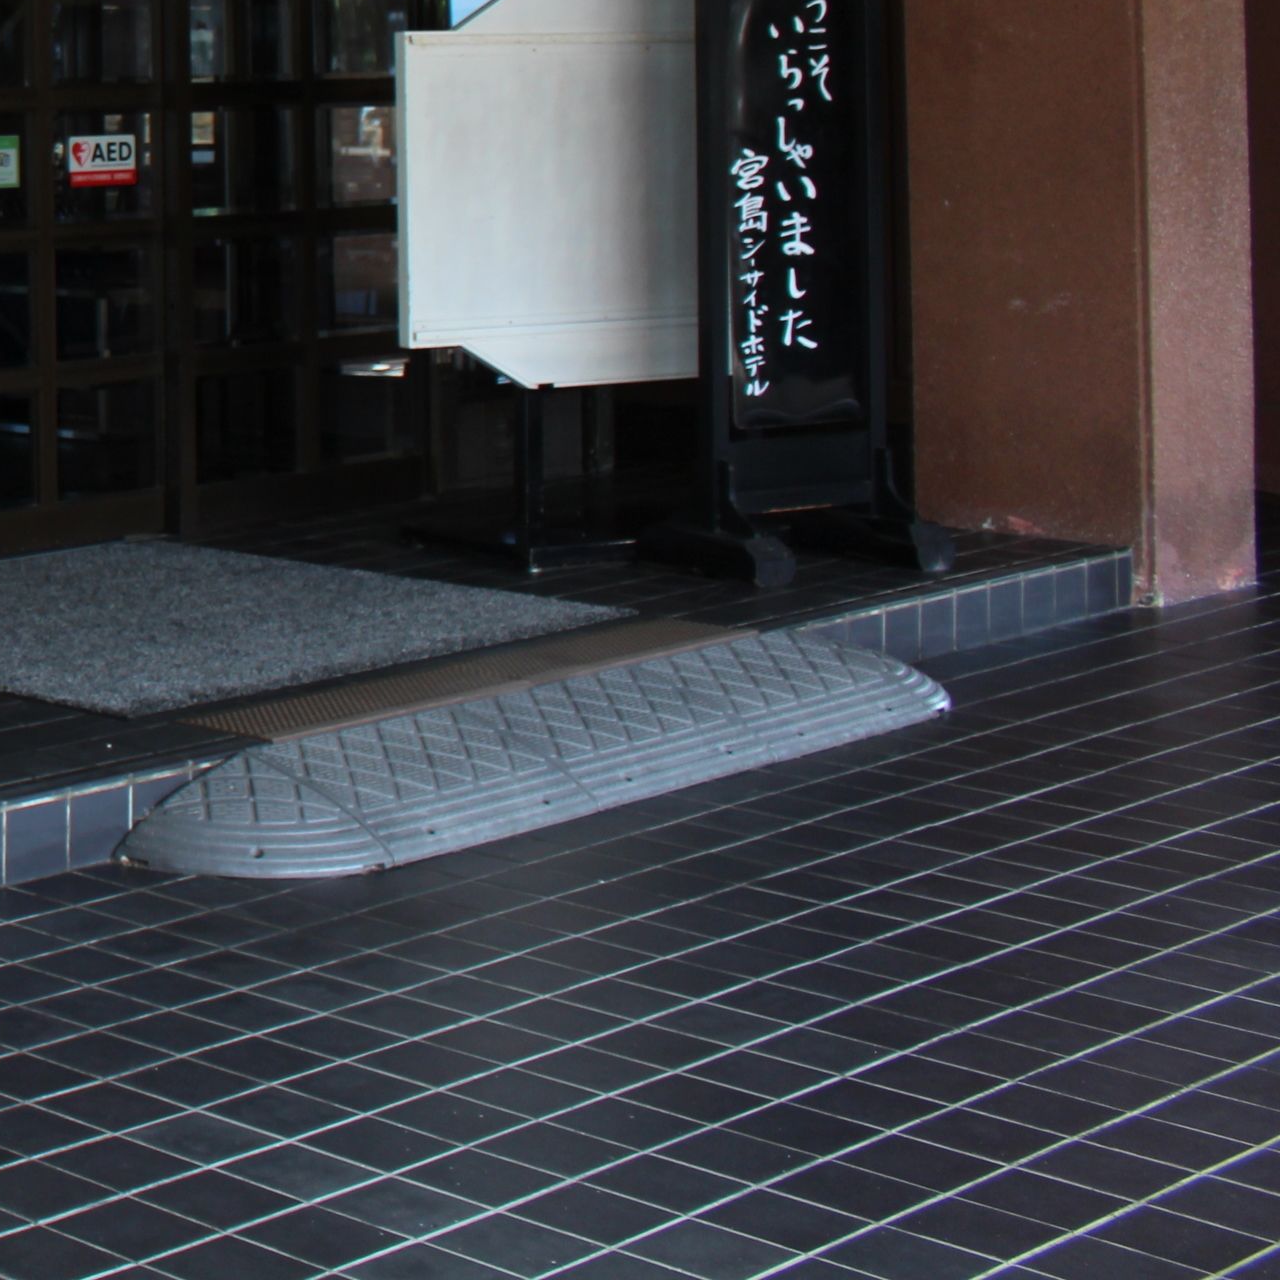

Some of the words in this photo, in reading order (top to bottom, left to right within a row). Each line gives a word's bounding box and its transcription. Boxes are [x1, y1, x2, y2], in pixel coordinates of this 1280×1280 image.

[91, 141, 132, 162] AED
[730, 148, 770, 397] 宮島シーサイドホテル
[769, 16, 818, 349] いらっしゃいました
